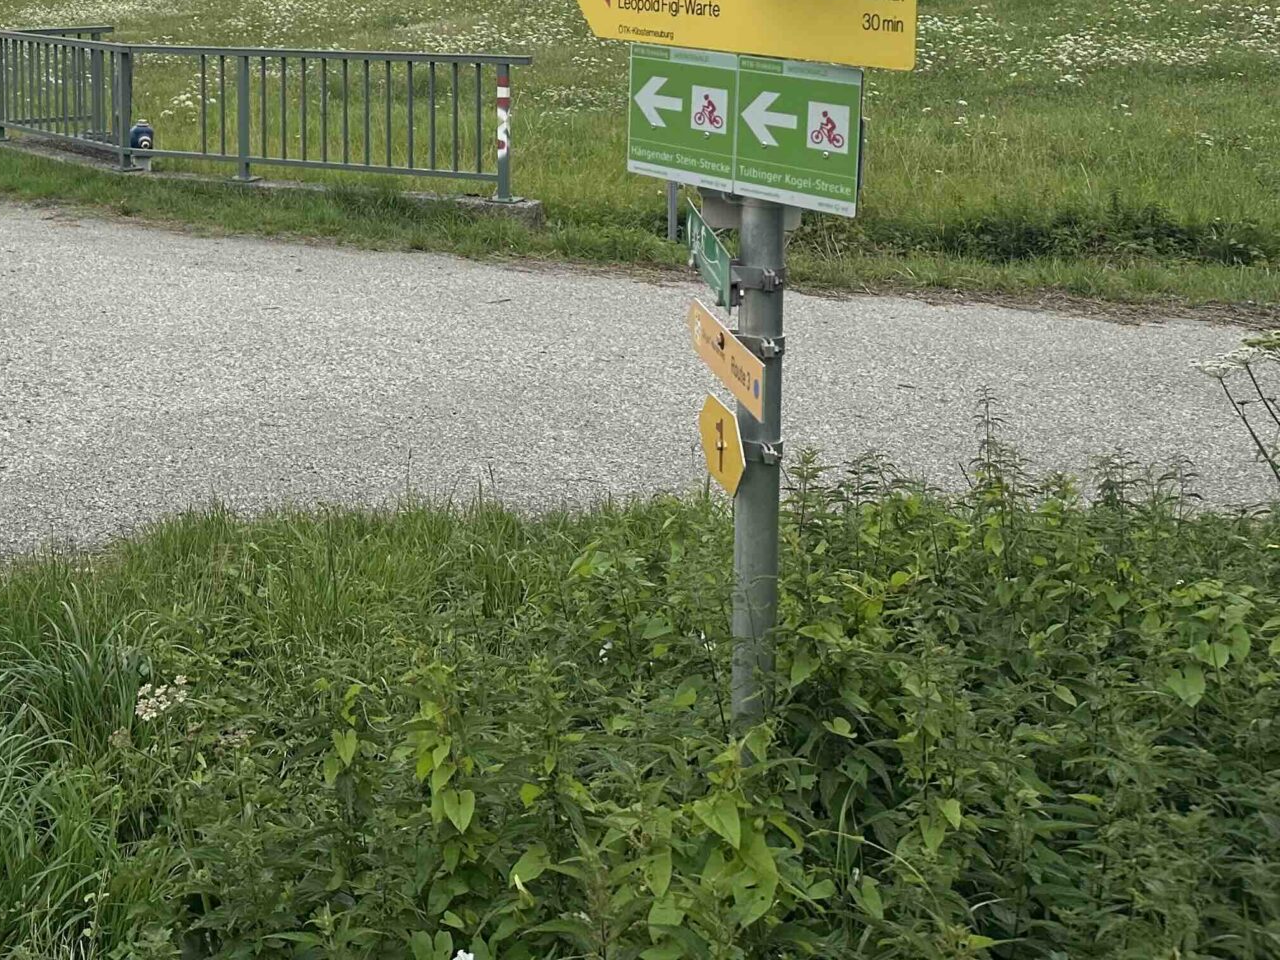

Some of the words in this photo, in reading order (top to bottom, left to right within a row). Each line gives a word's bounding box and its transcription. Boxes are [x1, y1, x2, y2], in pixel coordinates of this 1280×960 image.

[862, 12, 880, 31] 30
[882, 15, 904, 32] min
[675, 153, 731, 174] Stein-Strecke
[739, 164, 782, 183] Tulbinger
[784, 173, 852, 196] Kogel-Strecke
